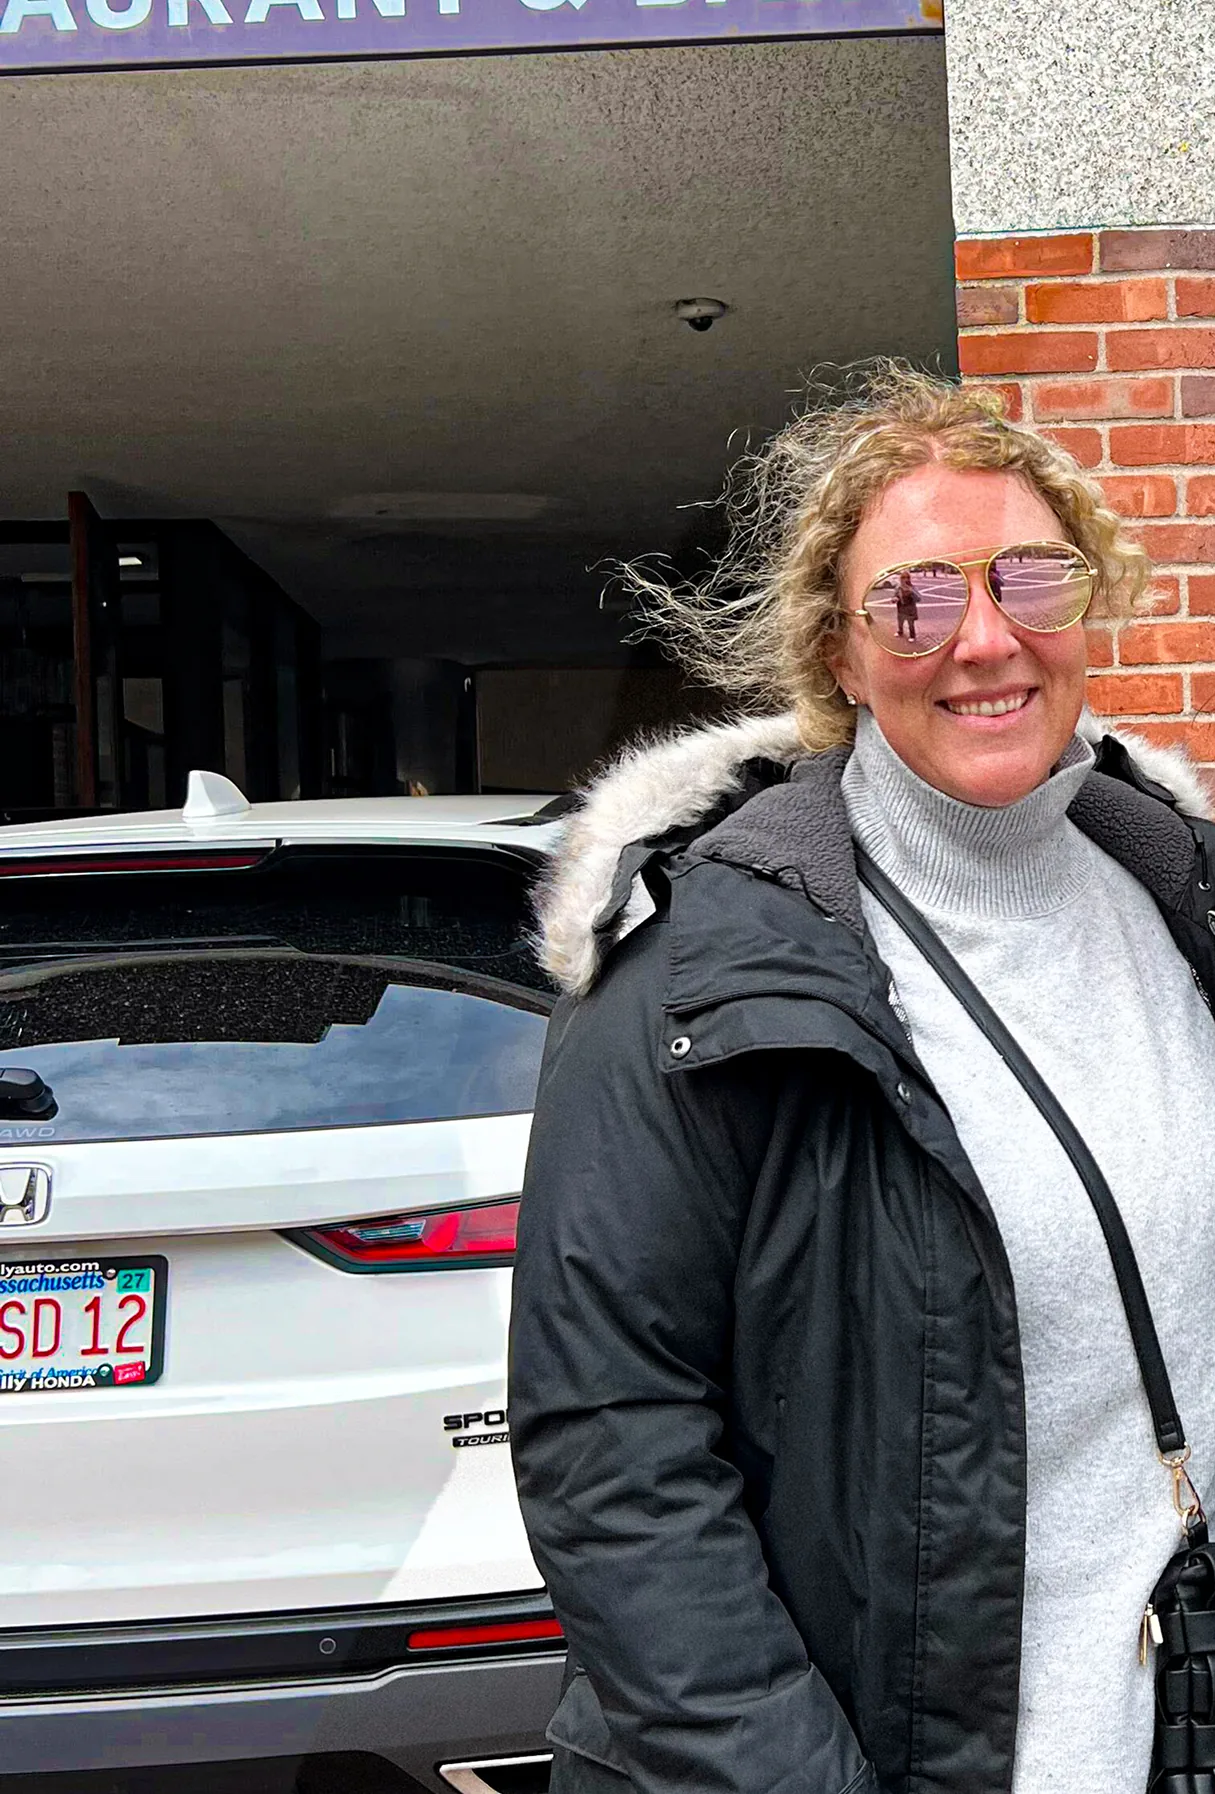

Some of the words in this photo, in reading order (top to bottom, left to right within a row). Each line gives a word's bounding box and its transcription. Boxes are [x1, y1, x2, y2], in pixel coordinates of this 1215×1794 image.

[0, 1127, 56, 1138] AWD
[1, 1262, 100, 1279] lyauto.com
[122, 1273, 145, 1289] 27
[0, 1297, 62, 1359] SD
[80, 1294, 147, 1356] 12
[31, 1375, 96, 1389] HONDA
[443, 1409, 508, 1431] SPO
[458, 1434, 510, 1446] TOURI
